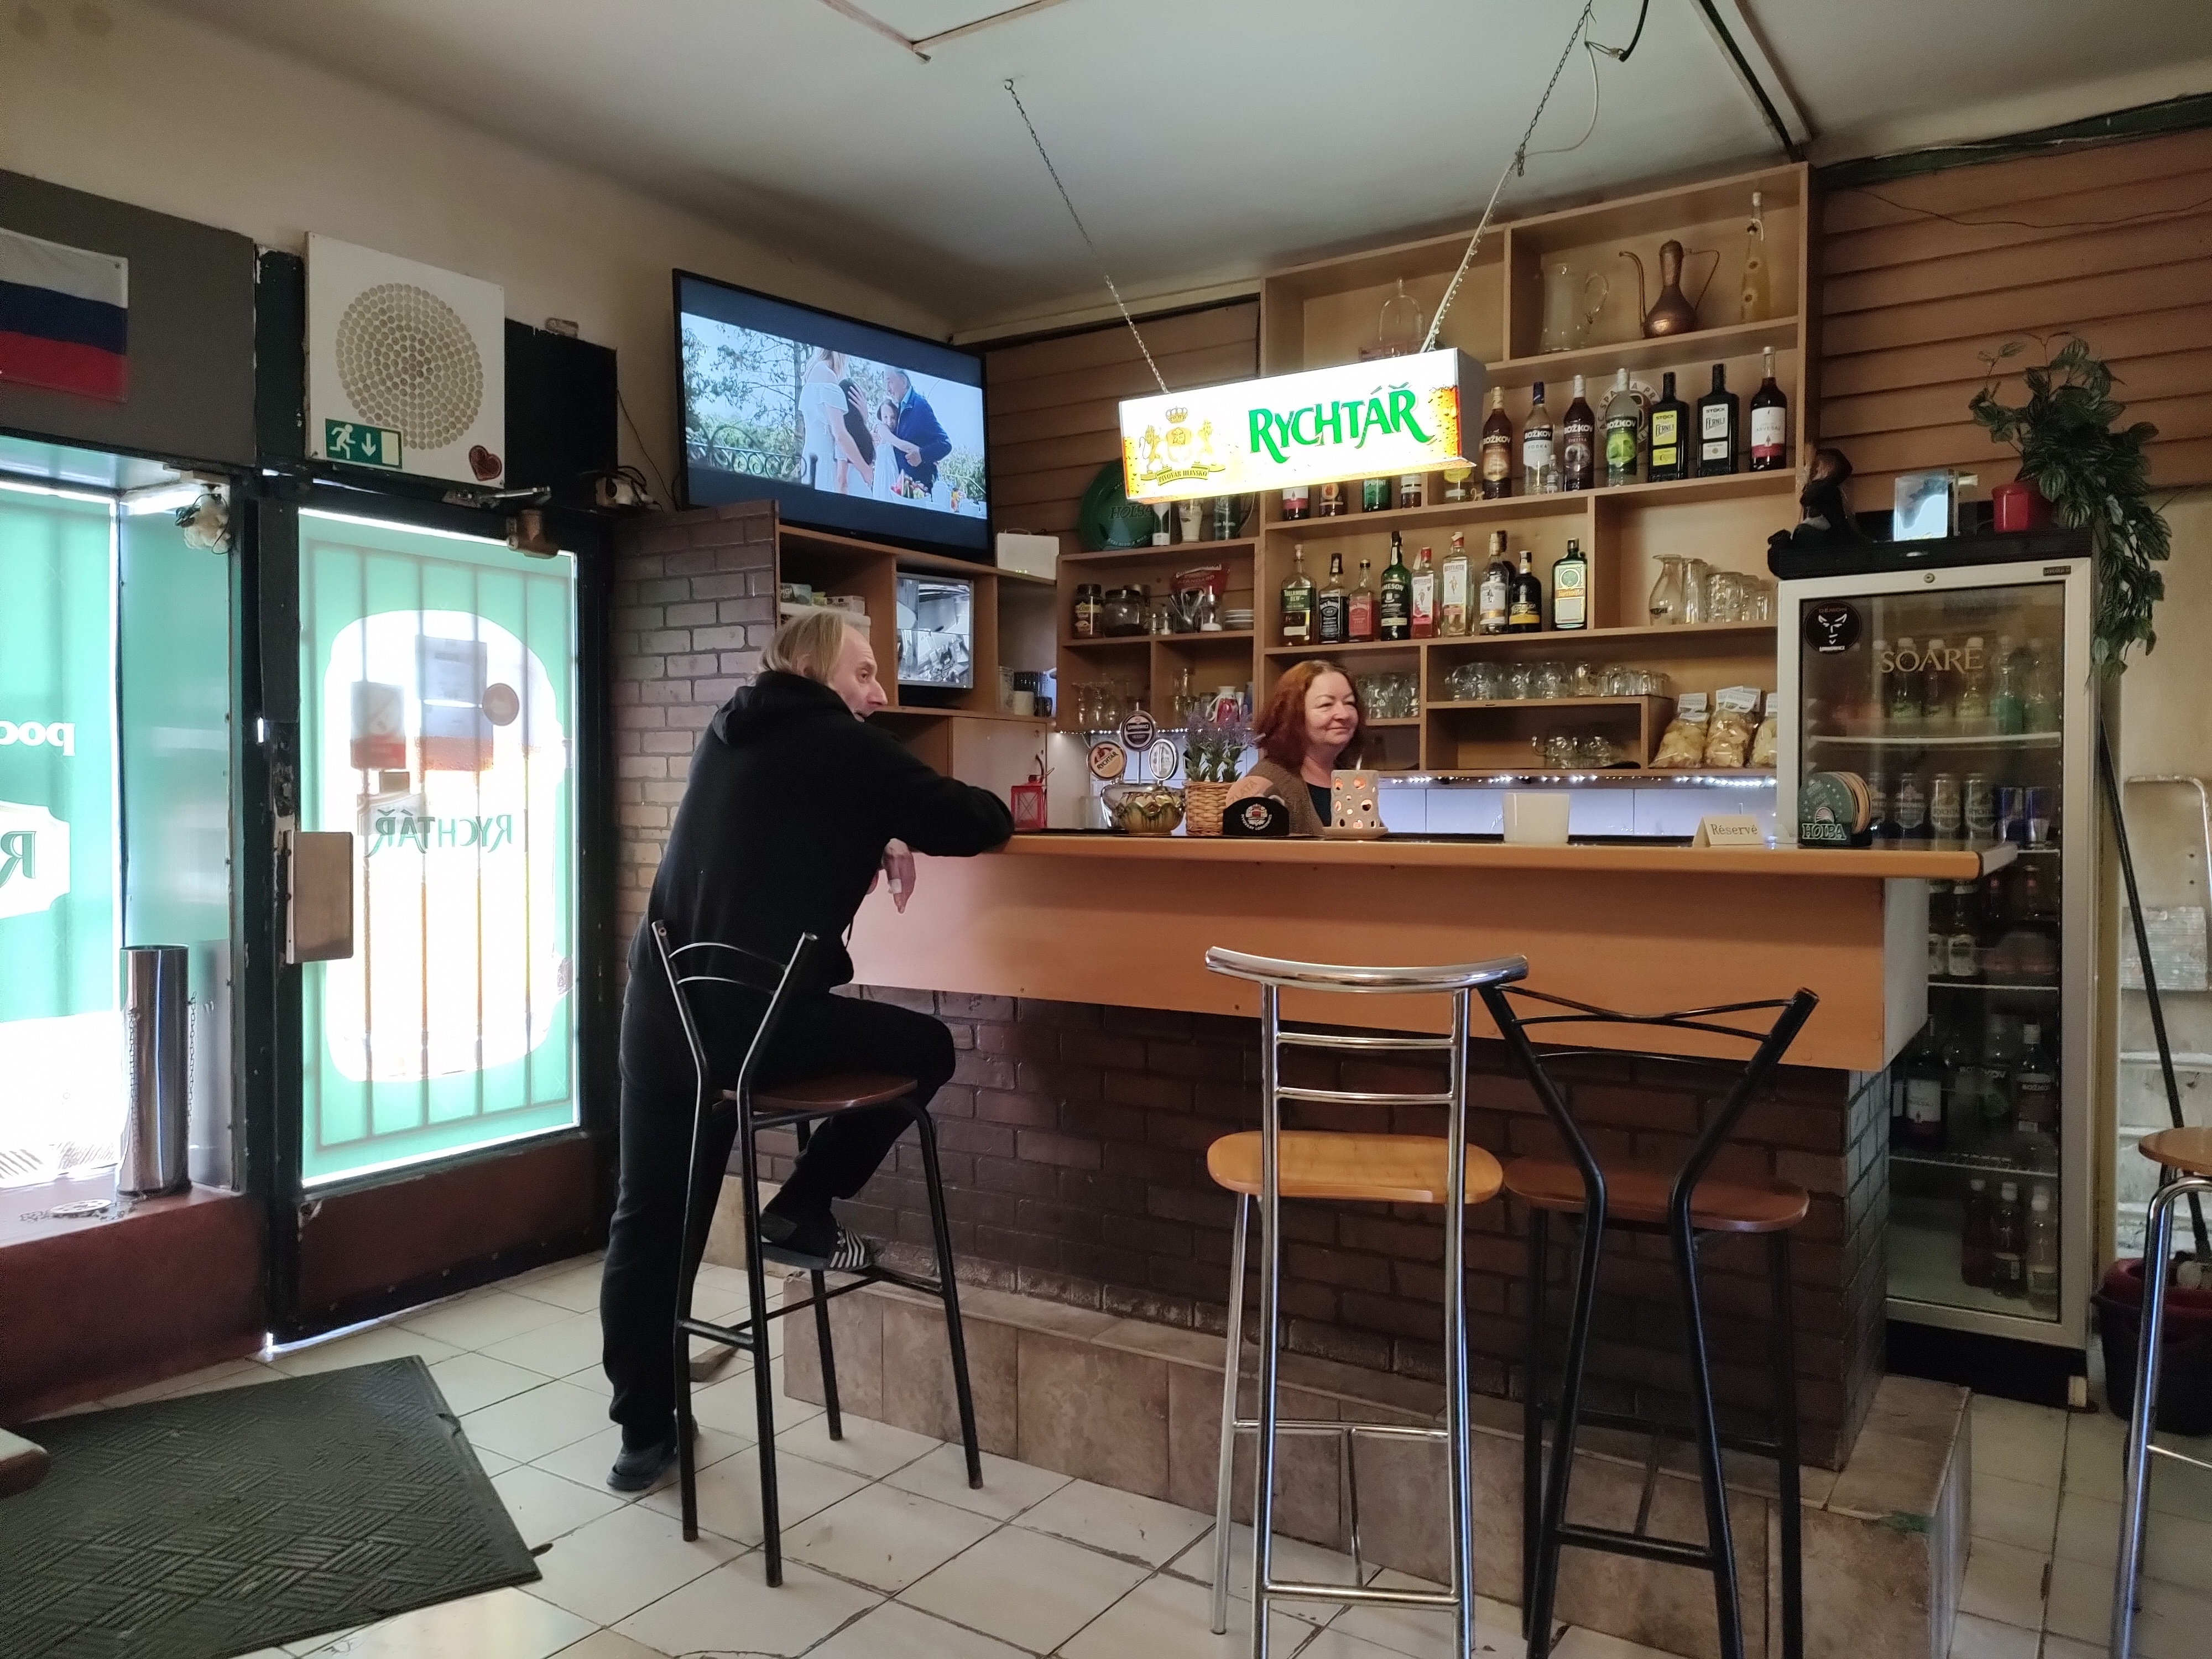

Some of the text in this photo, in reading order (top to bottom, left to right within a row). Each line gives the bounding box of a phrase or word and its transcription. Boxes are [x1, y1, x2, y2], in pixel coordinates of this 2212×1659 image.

[1248, 382, 1435, 463] RYCHTÁŘ
[1525, 430, 1552, 439] BOŽKOV
[1159, 471, 1181, 482] PIVOVAR
[1881, 647, 1984, 674] SOARE
[1802, 823, 1847, 840] HOLBA
